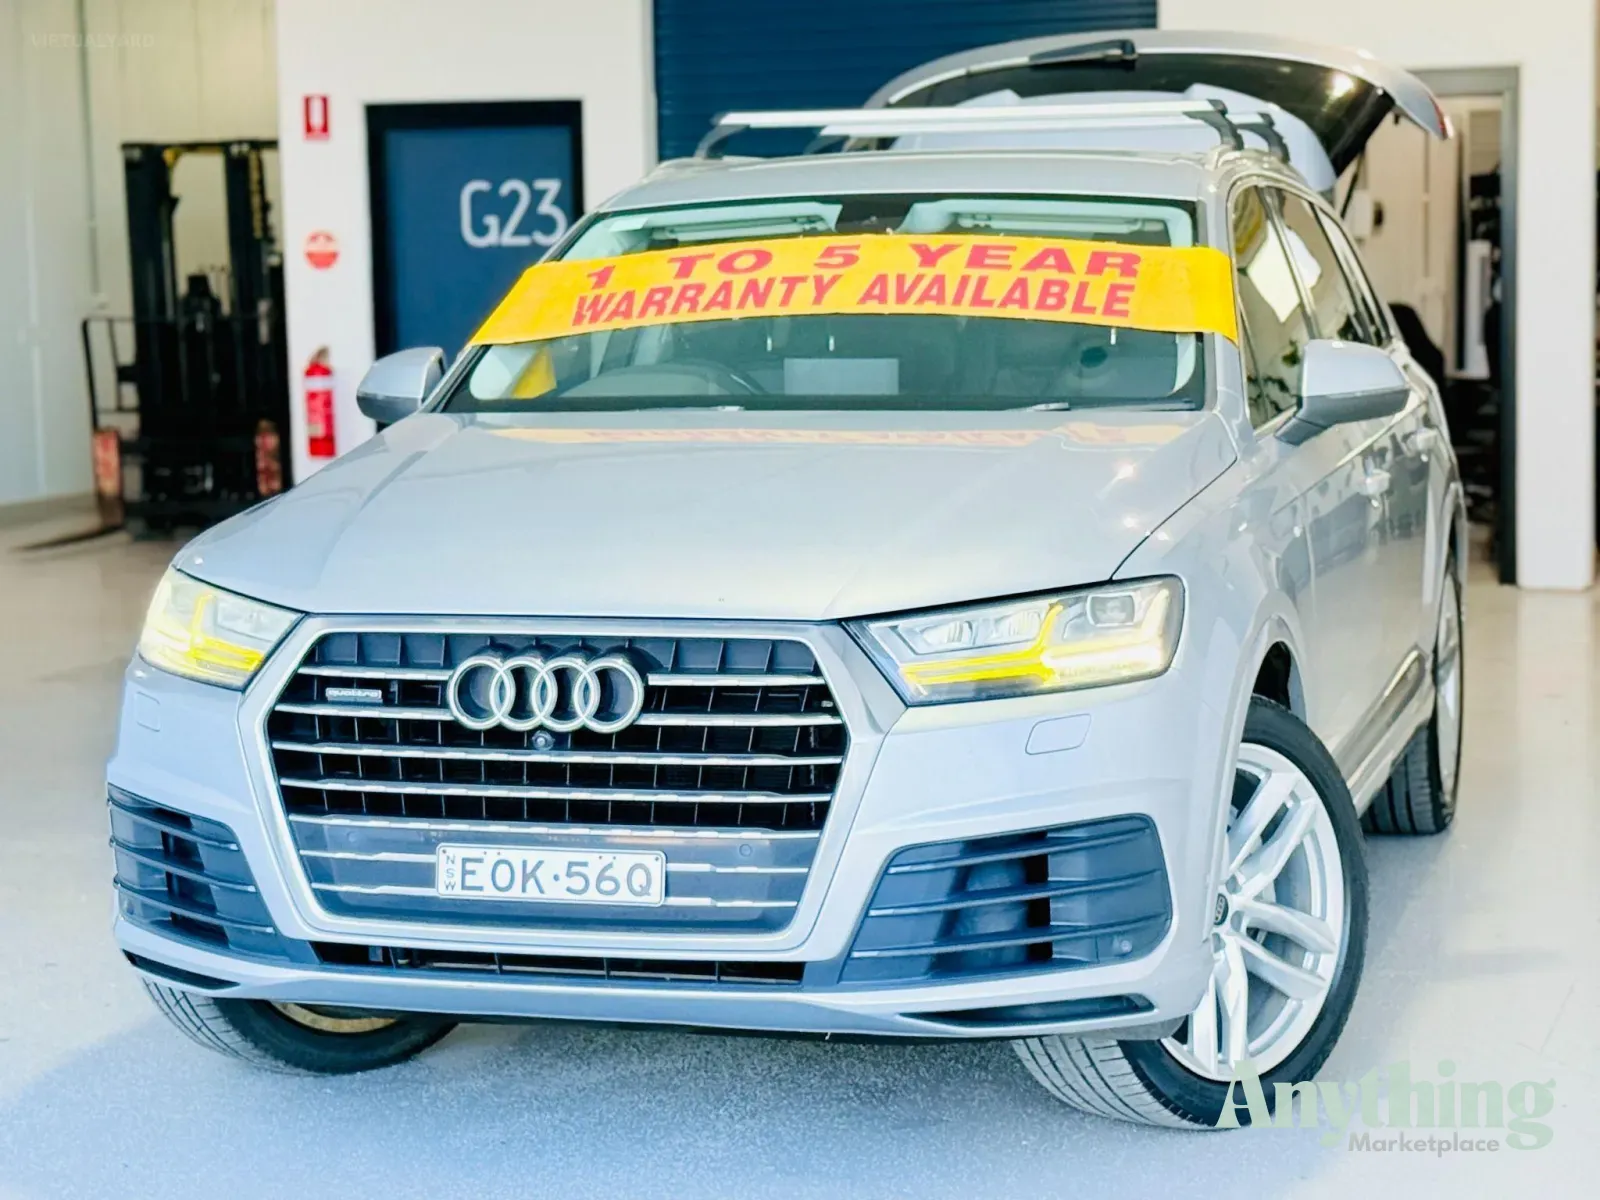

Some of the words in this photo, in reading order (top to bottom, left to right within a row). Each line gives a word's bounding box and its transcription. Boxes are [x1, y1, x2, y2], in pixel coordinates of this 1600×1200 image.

[460, 179, 567, 248] G23
[586, 265, 615, 289] 1
[667, 249, 773, 279] TO
[812, 244, 861, 270] 5
[908, 243, 1142, 279] YEAR
[571, 273, 842, 327] WARRANTY
[857, 274, 1135, 318] AVAILABLE
